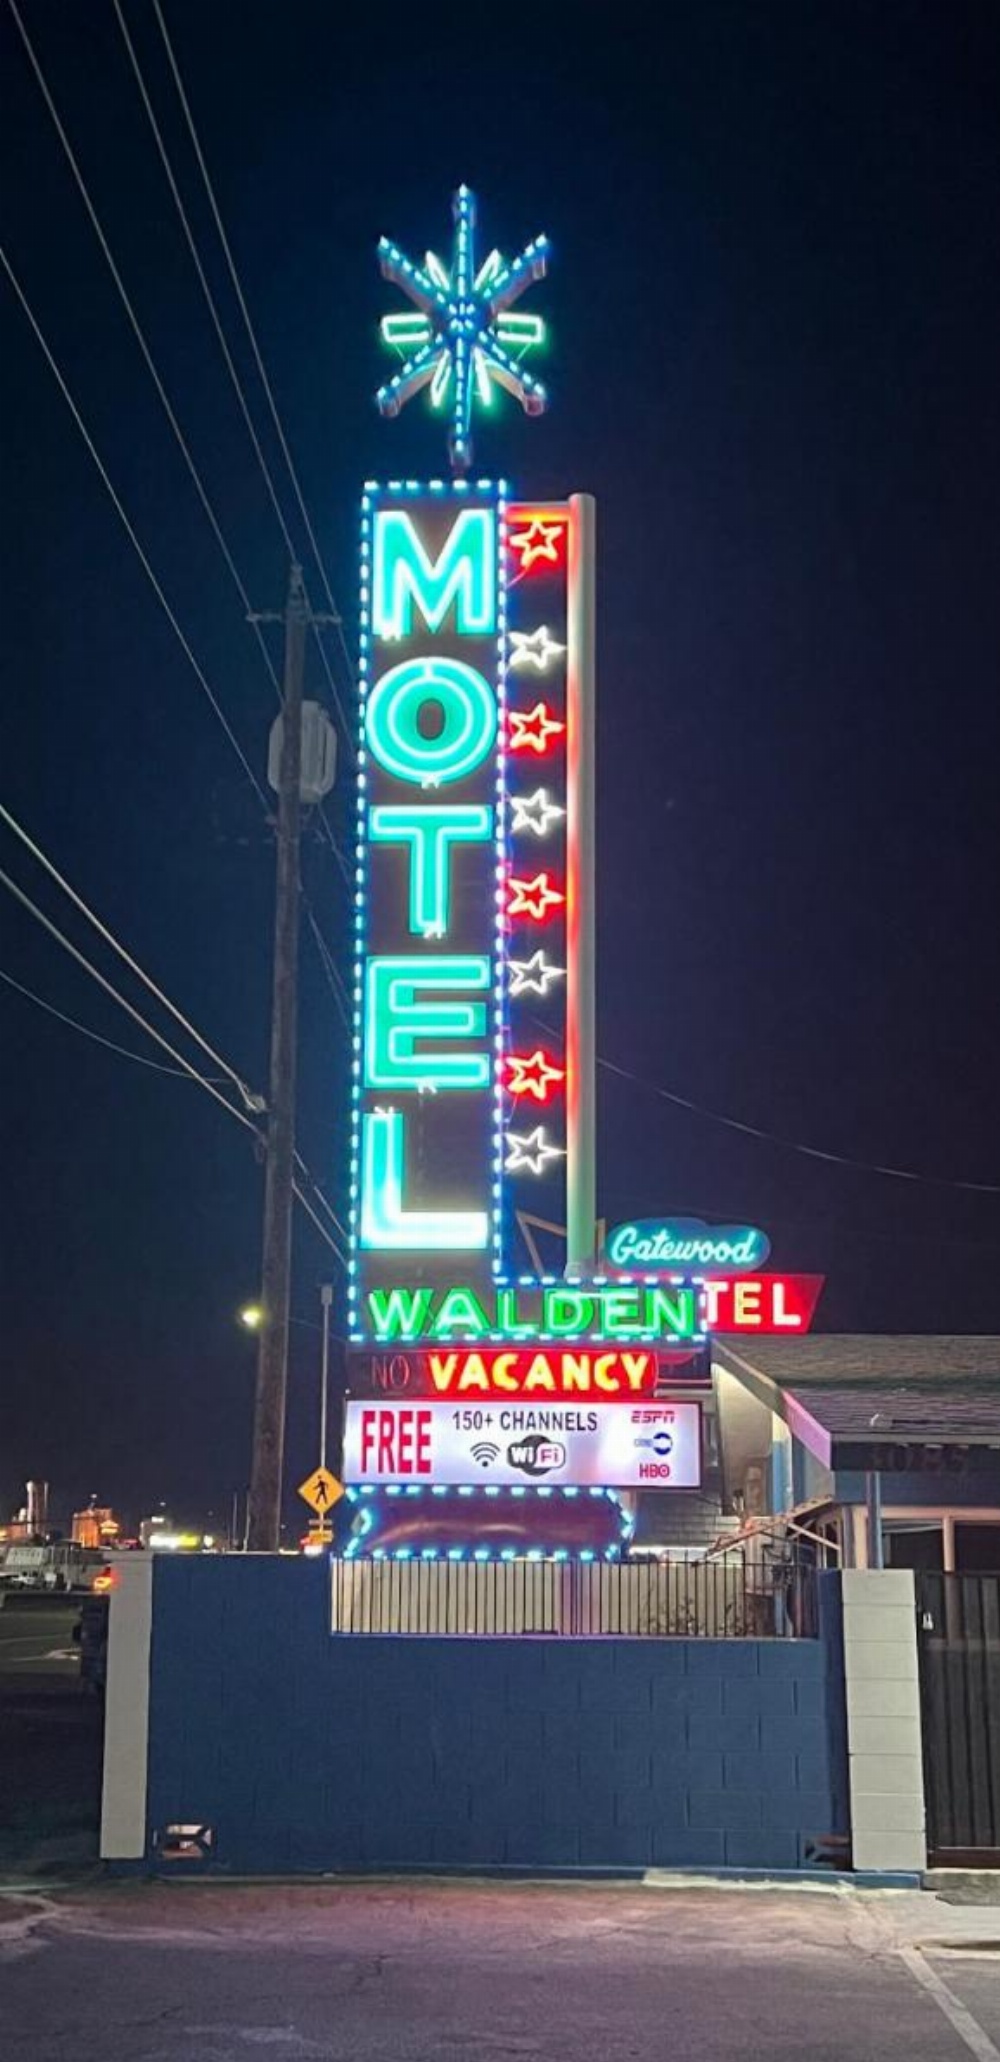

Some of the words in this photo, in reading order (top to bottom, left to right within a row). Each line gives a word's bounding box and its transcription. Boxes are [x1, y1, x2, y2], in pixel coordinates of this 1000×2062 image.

[360, 507, 498, 1250] MOTEL
[611, 1226, 757, 1264] Gatewood
[369, 1288, 694, 1336] WALDEN
[703, 1281, 801, 1326] TEL
[371, 1355, 409, 1389] NO
[428, 1352, 649, 1391] VACANCY
[452, 1410, 494, 1431] 150+
[499, 1410, 598, 1431] CHANNELS
[631, 1410, 675, 1424] ESPN
[361, 1410, 432, 1474] FREE
[639, 1463, 671, 1479] HBO
